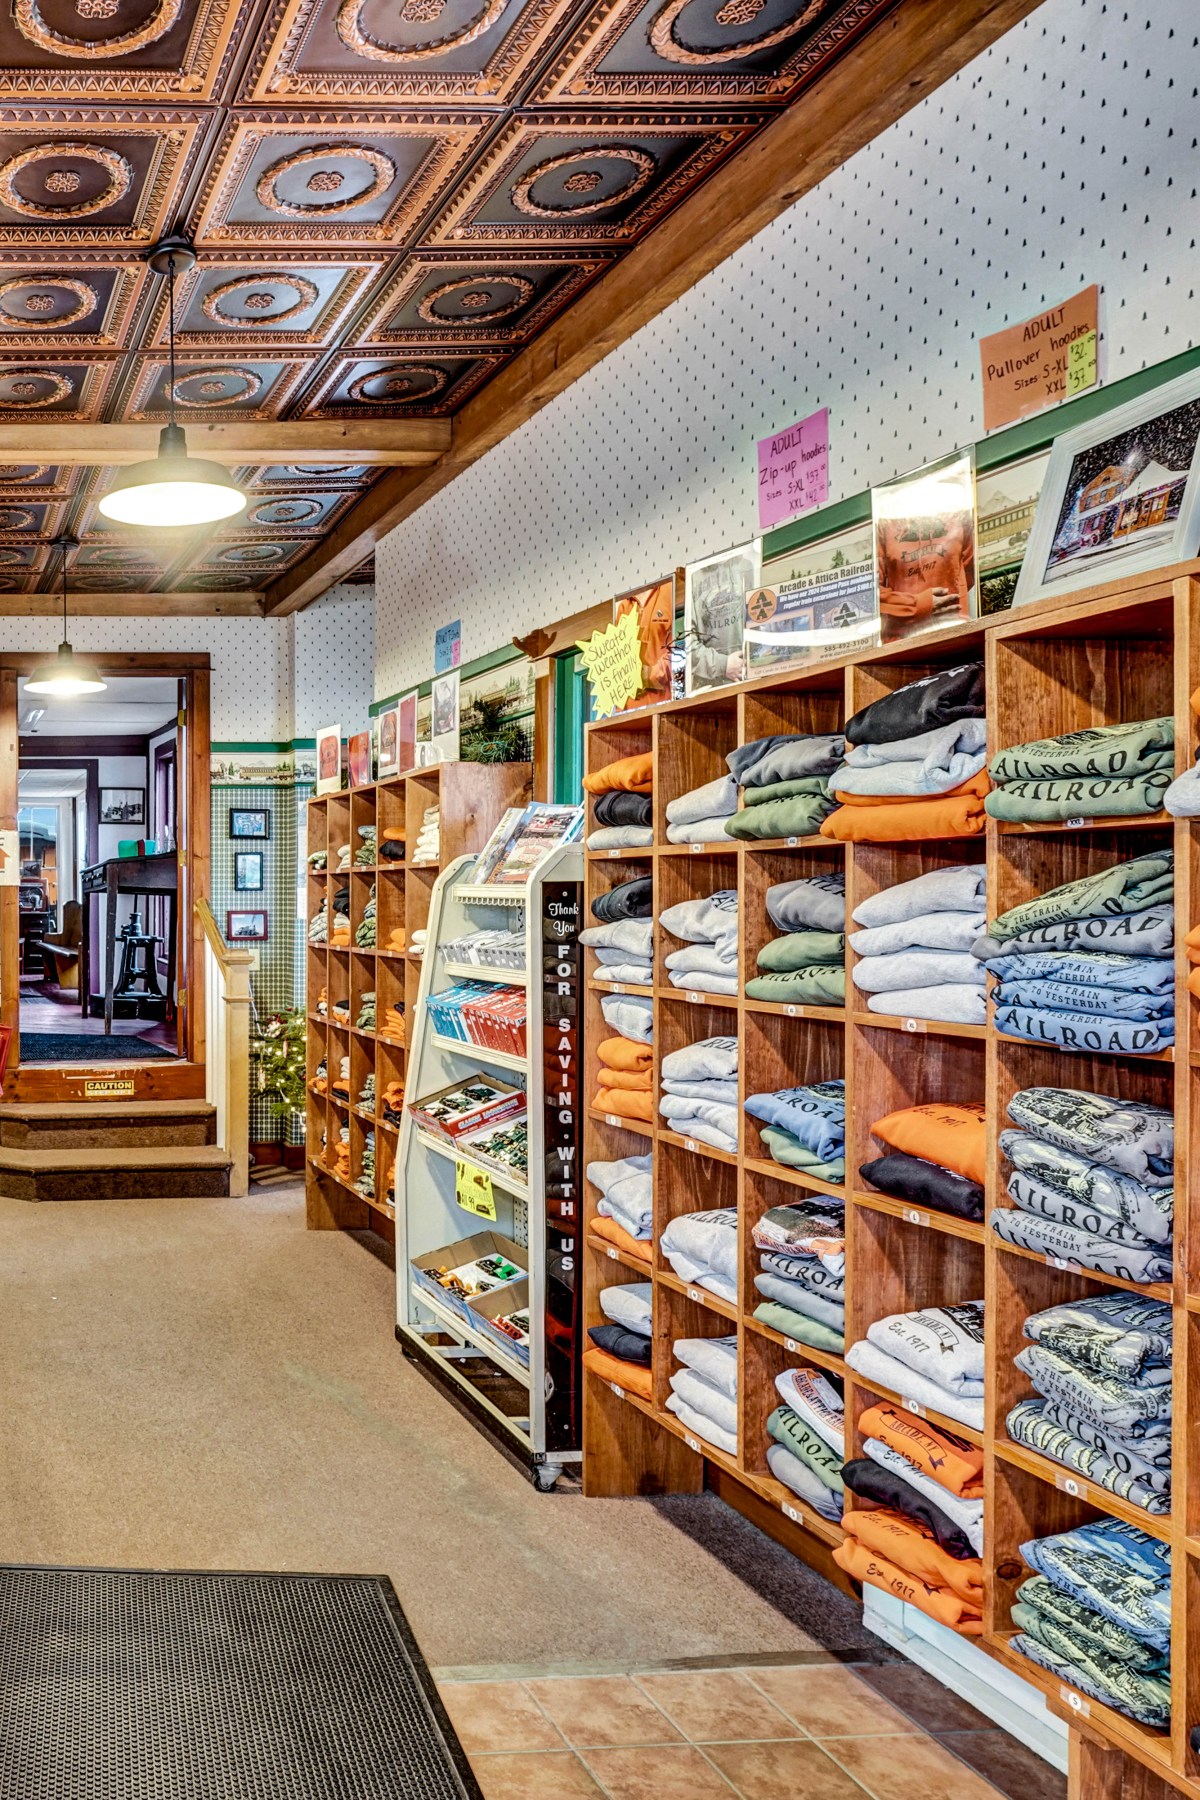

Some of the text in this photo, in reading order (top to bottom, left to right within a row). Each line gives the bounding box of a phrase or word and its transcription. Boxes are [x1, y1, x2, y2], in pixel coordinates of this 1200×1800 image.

[1023, 308, 1065, 342] ADULT
[987, 323, 1090, 381] Pullover hoodies
[1043, 356, 1069, 379] S-XL
[1046, 378, 1066, 395] XXL
[770, 426, 803, 458] ADULT
[760, 443, 826, 485] Zip-up hoodies
[788, 479, 804, 495] S-XL
[789, 499, 804, 511] XXL
[779, 572, 838, 593] Arcade Attica
[820, 583, 838, 593] Season
[588, 625, 628, 662] Sweater
[824, 639, 869, 652] 585-492-3100
[594, 636, 633, 676] weather
[613, 655, 638, 684] finally
[609, 675, 634, 704] HERE
[1029, 749, 1080, 758] YESTERDAY
[549, 903, 579, 918] Thank
[1014, 903, 1063, 925] THE TRAIN
[1024, 908, 1073, 931] YESTERDAY
[553, 919, 575, 937] You
[557, 945, 571, 996] FOR
[1026, 968, 1037, 976] TO
[1035, 961, 1095, 974] THE TRAIN
[1031, 986, 1108, 1010] TO YESTERDAY
[1041, 981, 1100, 1000] THE TRAIN
[1047, 1007, 1105, 1025] YESTERDAY
[557, 1018, 573, 1126] SAVING
[87, 1082, 132, 1090] CAUTION
[557, 1146, 575, 1216] WITH
[1010, 1217, 1082, 1252] TO YESTERDAY
[1021, 1215, 1076, 1242] THE TRAIN
[560, 1239, 574, 1271] US
[887, 1321, 930, 1354] Est. 1917
[1034, 1369, 1099, 1418] TO YESTERDAY
[1043, 1366, 1094, 1406] THE TRAIN
[1058, 1398, 1076, 1416] THE
[890, 1576, 916, 1598] 1917
[1056, 1575, 1079, 1597] THE
[1038, 1659, 1061, 1678] THE
